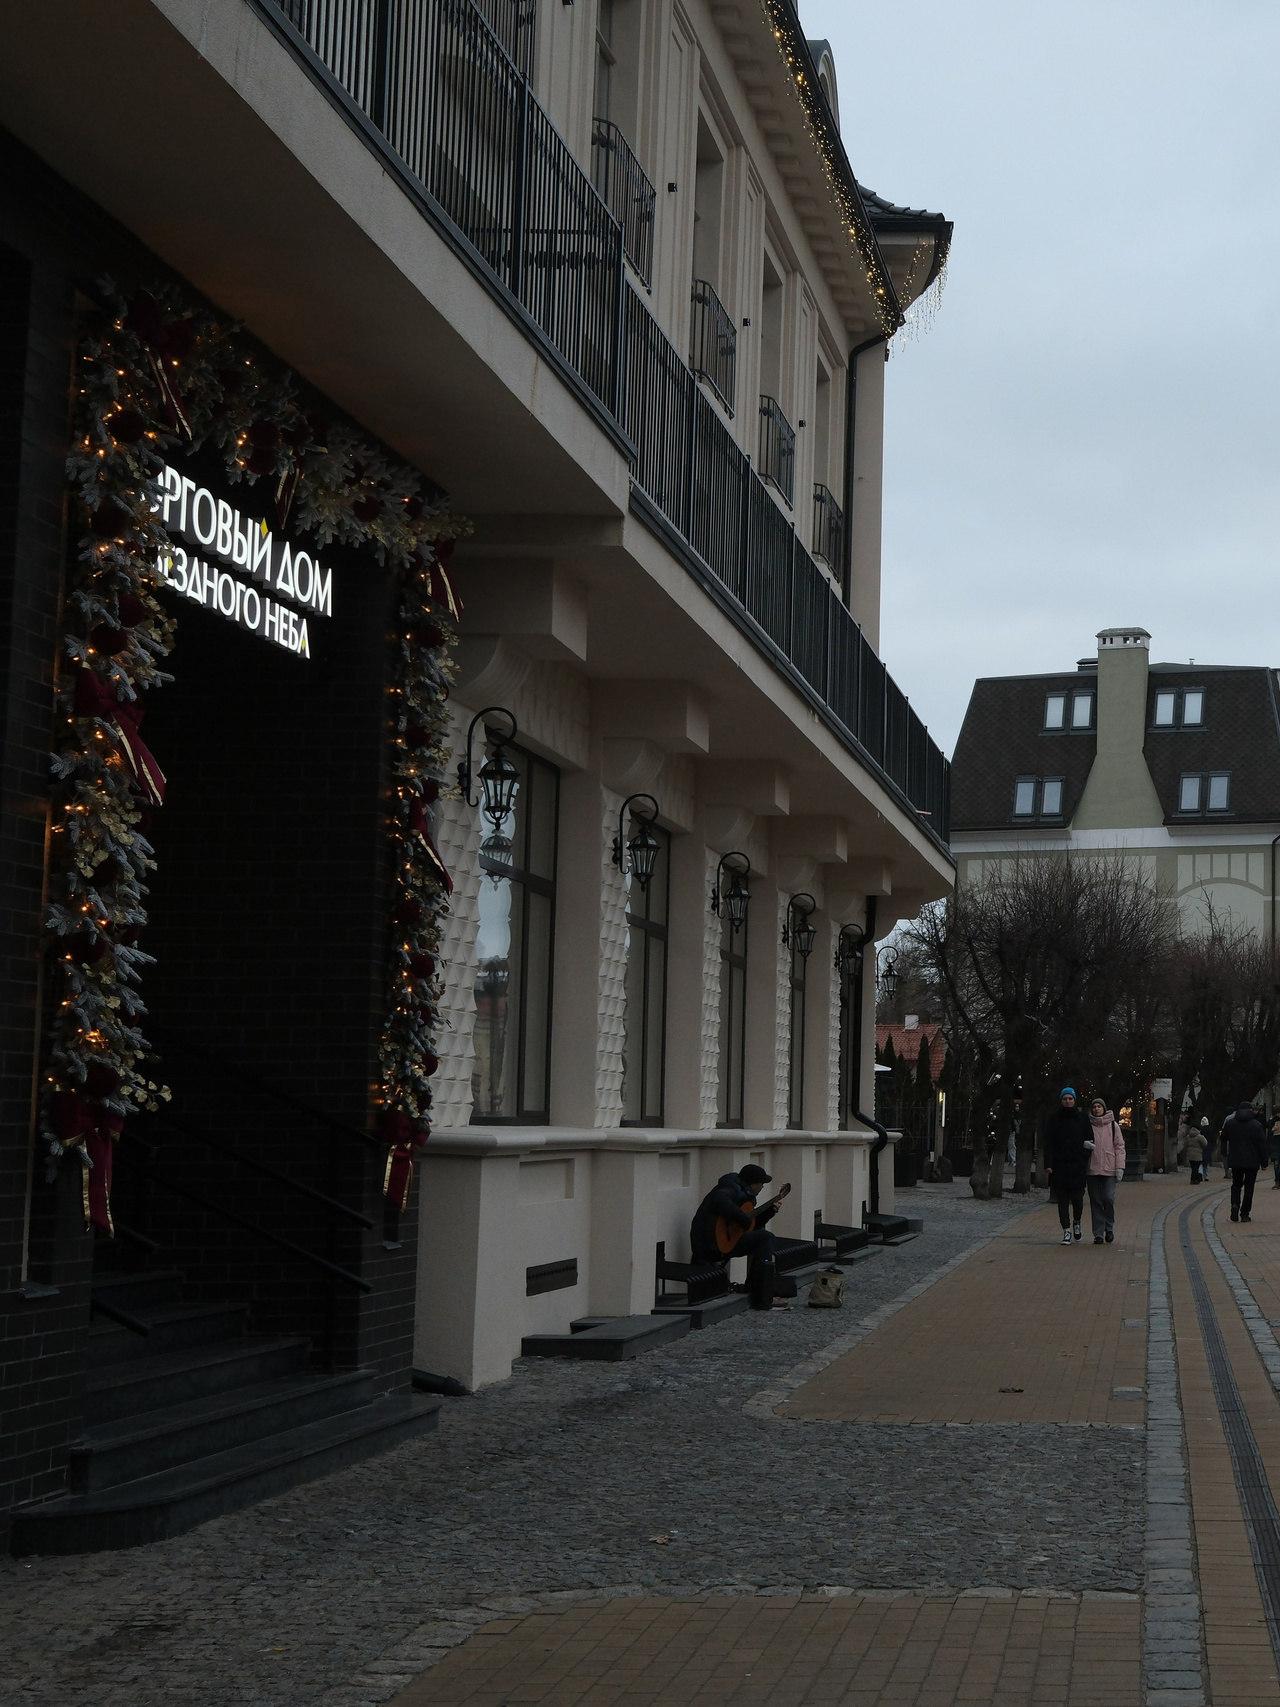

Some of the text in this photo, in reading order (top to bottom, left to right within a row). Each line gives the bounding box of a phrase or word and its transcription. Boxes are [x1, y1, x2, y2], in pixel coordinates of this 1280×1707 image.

[141, 464, 332, 618] РГОВЫЙ ДОМ
[264, 597, 311, 659] НЕБА
